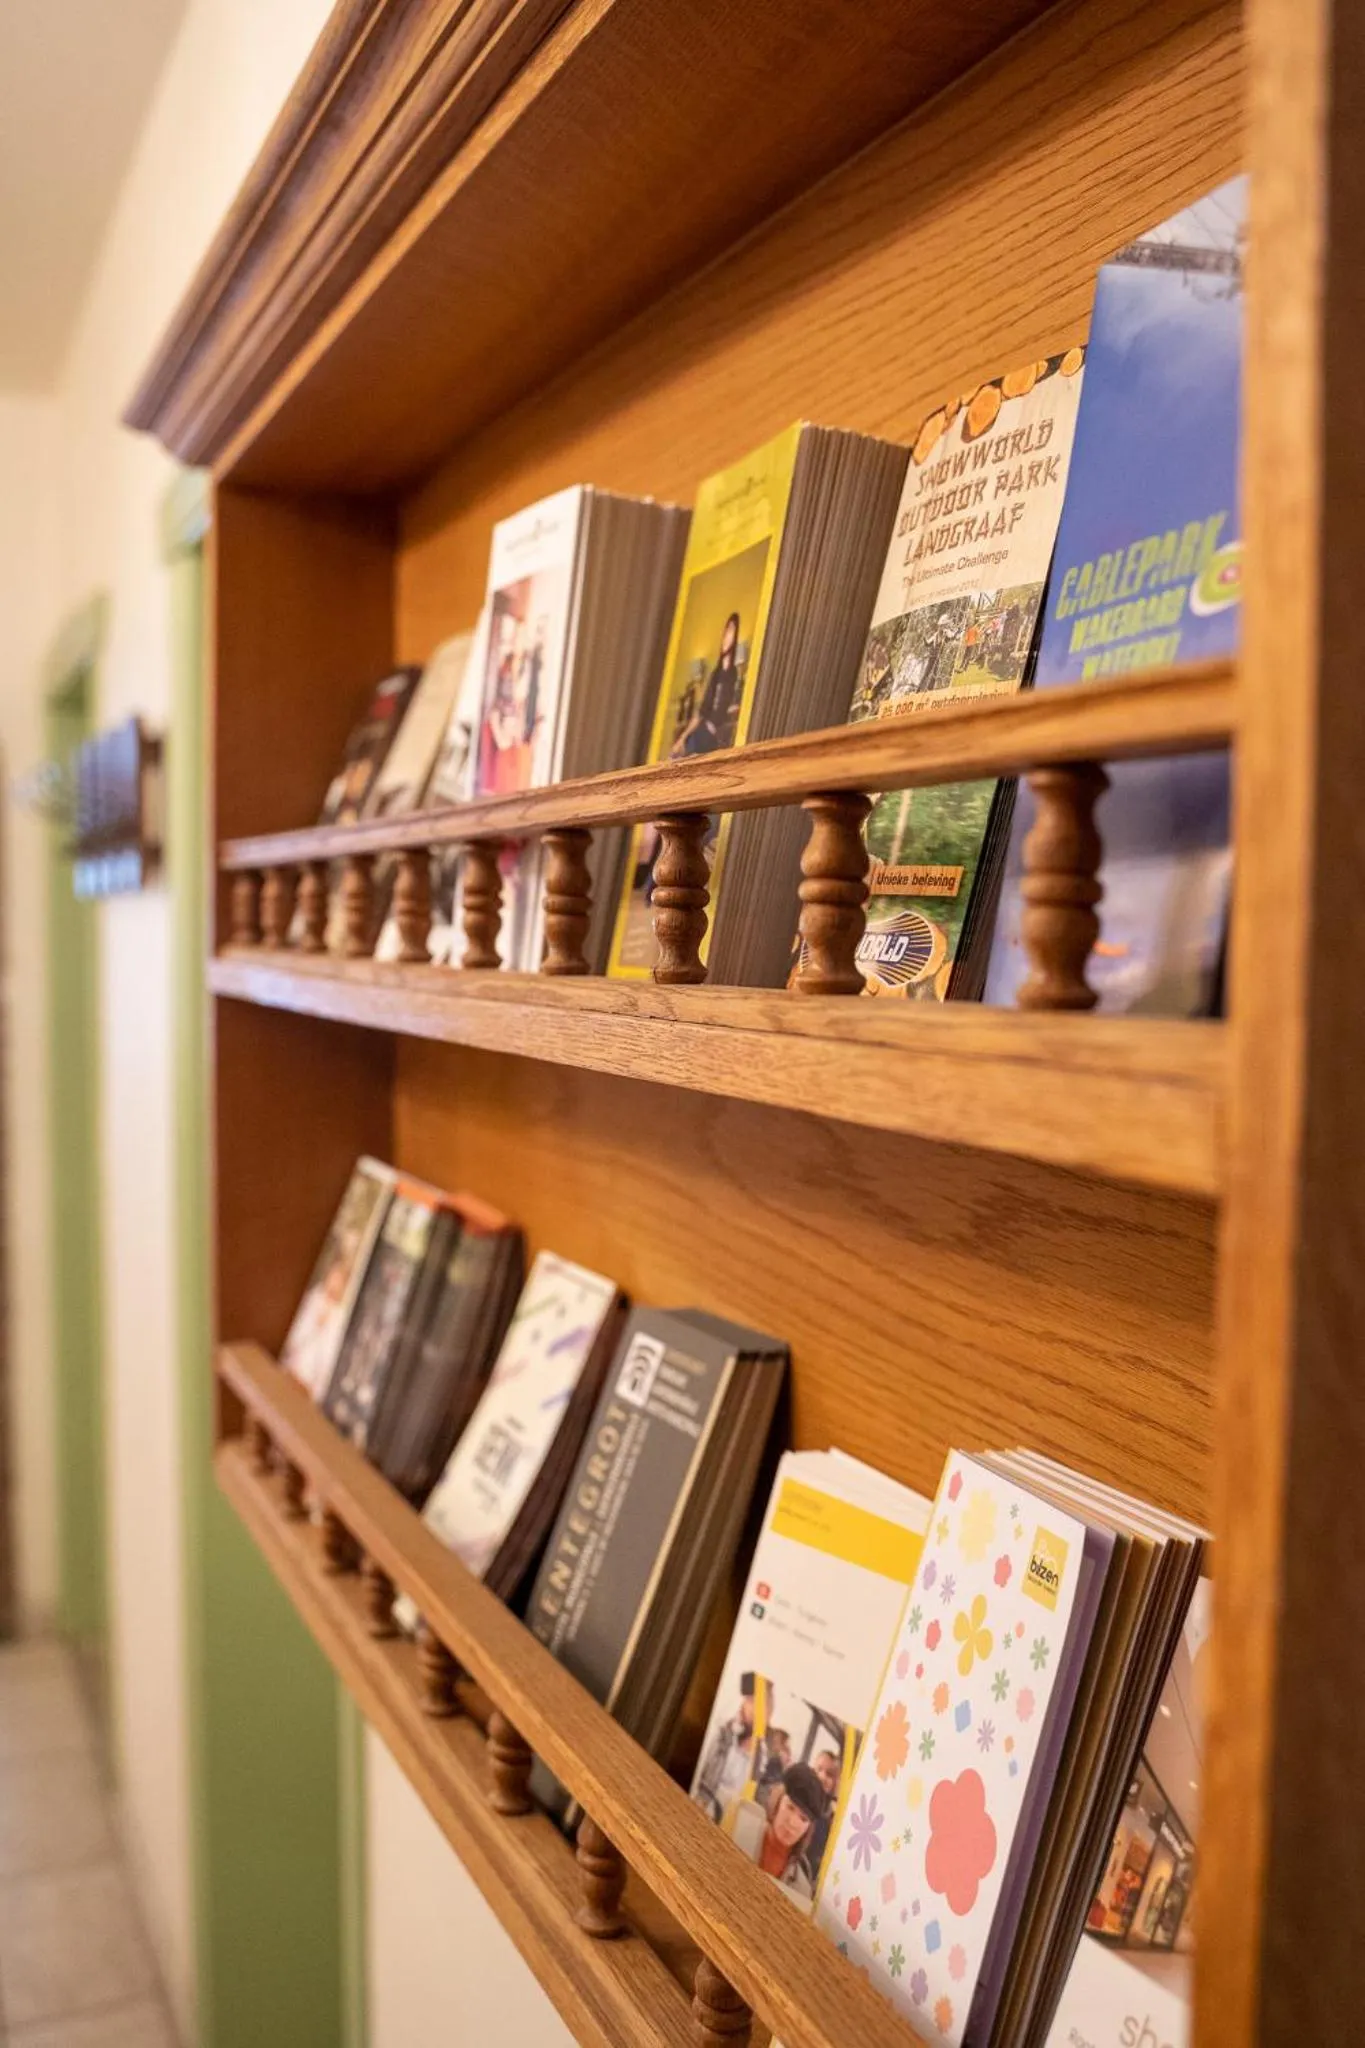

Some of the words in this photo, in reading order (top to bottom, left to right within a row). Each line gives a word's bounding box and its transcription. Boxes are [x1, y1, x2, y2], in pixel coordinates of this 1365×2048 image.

[915, 418, 1054, 496] SNOWWORLD
[897, 475, 989, 537] OUTDOOR
[994, 454, 1061, 499] PARK
[903, 502, 1025, 566] LANDGRAAF
[957, 549, 1009, 571] Challenge
[876, 871, 909, 886] Unieke
[911, 872, 957, 891] beleving
